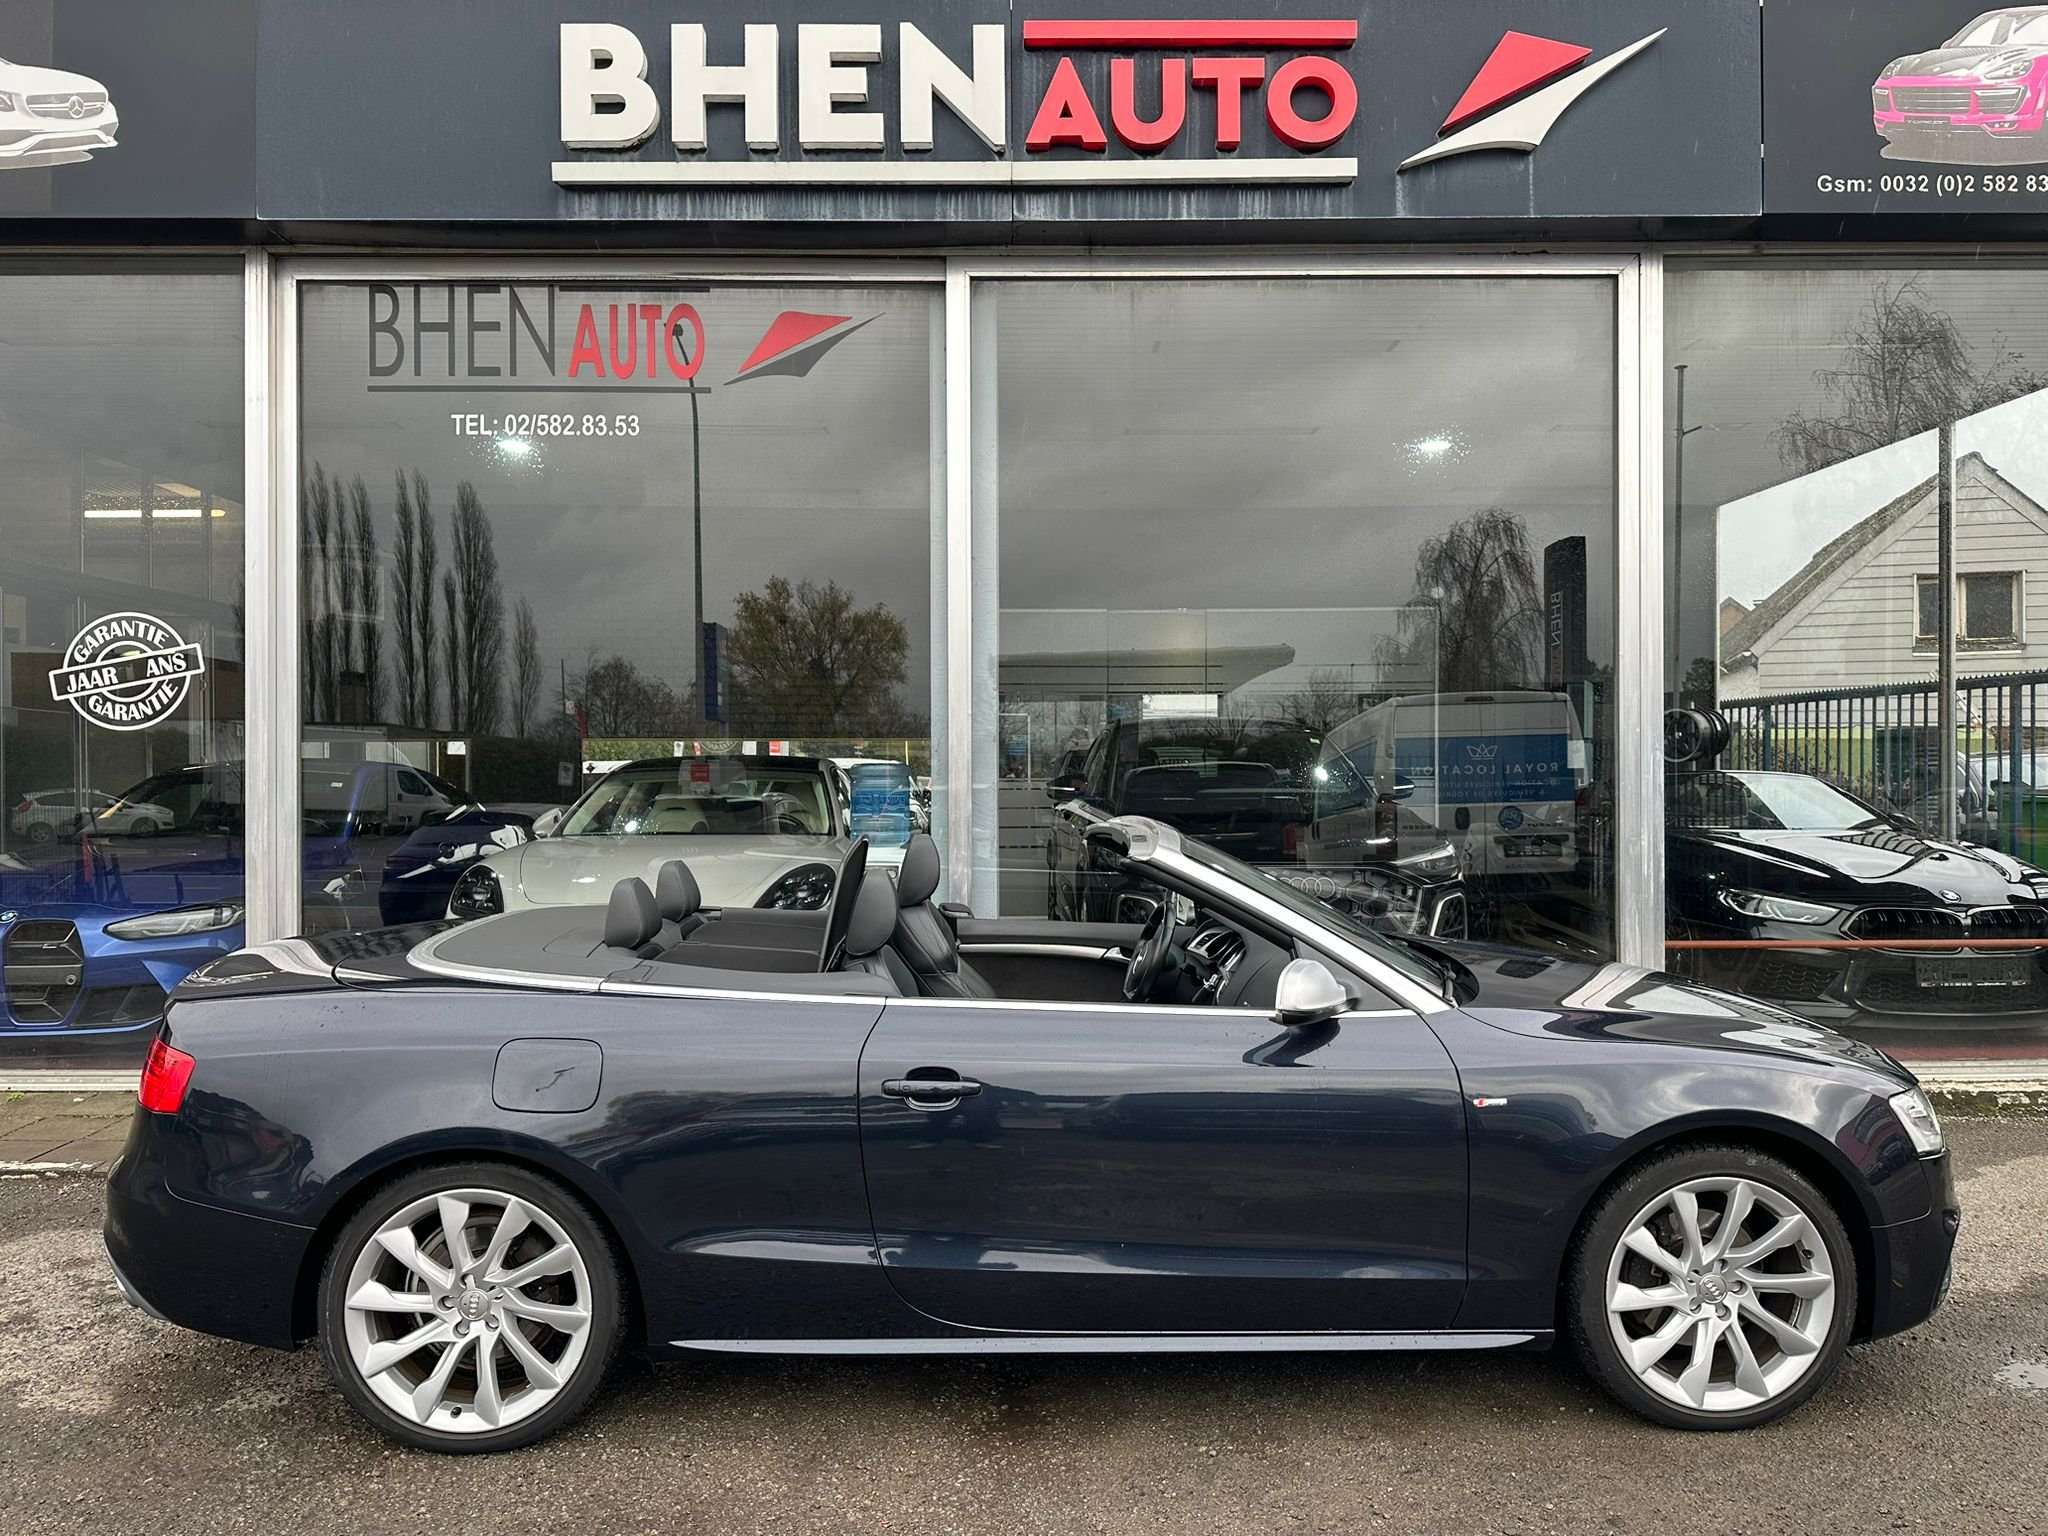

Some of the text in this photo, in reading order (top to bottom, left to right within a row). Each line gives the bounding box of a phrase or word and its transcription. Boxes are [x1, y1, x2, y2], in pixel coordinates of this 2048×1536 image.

[560, 24, 1358, 153] BHEN AUTO
[1817, 174, 1873, 192] Gsm:
[1881, 174, 1929, 192] 0032
[1937, 174, 1975, 196] (0)2
[1982, 174, 2018, 192] 582
[368, 284, 705, 380] BHEN AUTO
[451, 414, 640, 437] TEL: 02/582.83.53
[75, 620, 169, 662] GARANTIE
[67, 653, 187, 693] JAAR ANS
[88, 681, 178, 721] GARANTIE
